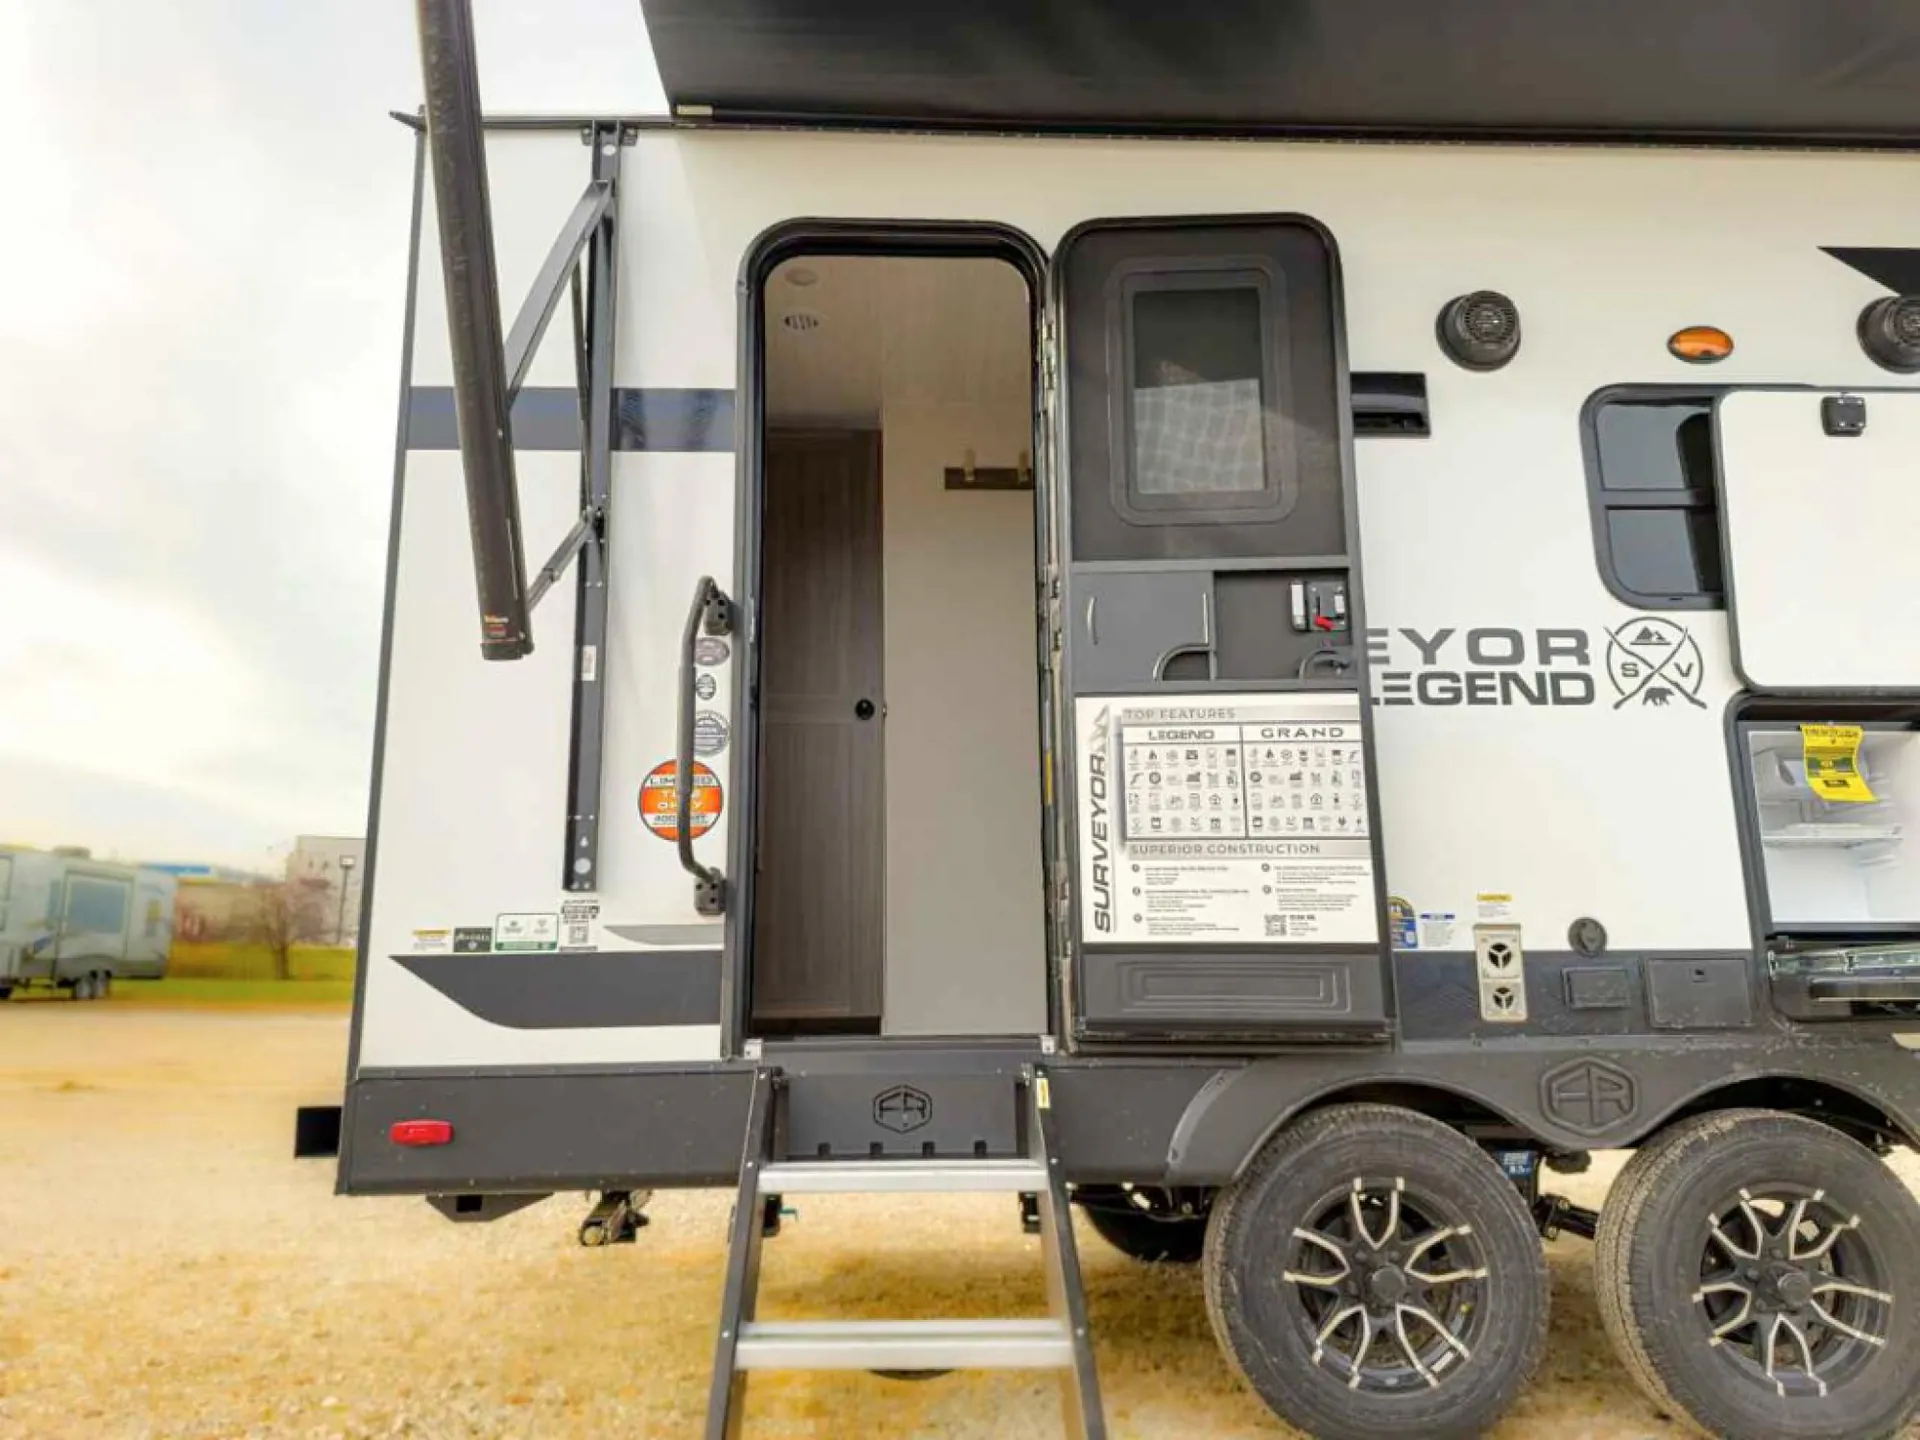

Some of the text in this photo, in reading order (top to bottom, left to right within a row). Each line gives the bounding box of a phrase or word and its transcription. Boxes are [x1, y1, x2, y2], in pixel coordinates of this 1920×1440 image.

[1123, 707, 1236, 720] TOP FEATURES
[1148, 729, 1215, 740] LEGEND
[1260, 727, 1344, 739] GRAND
[1089, 753, 1111, 934] SURVEYOR
[1131, 843, 1321, 855] SUPERIOR CONSTRUCTION
